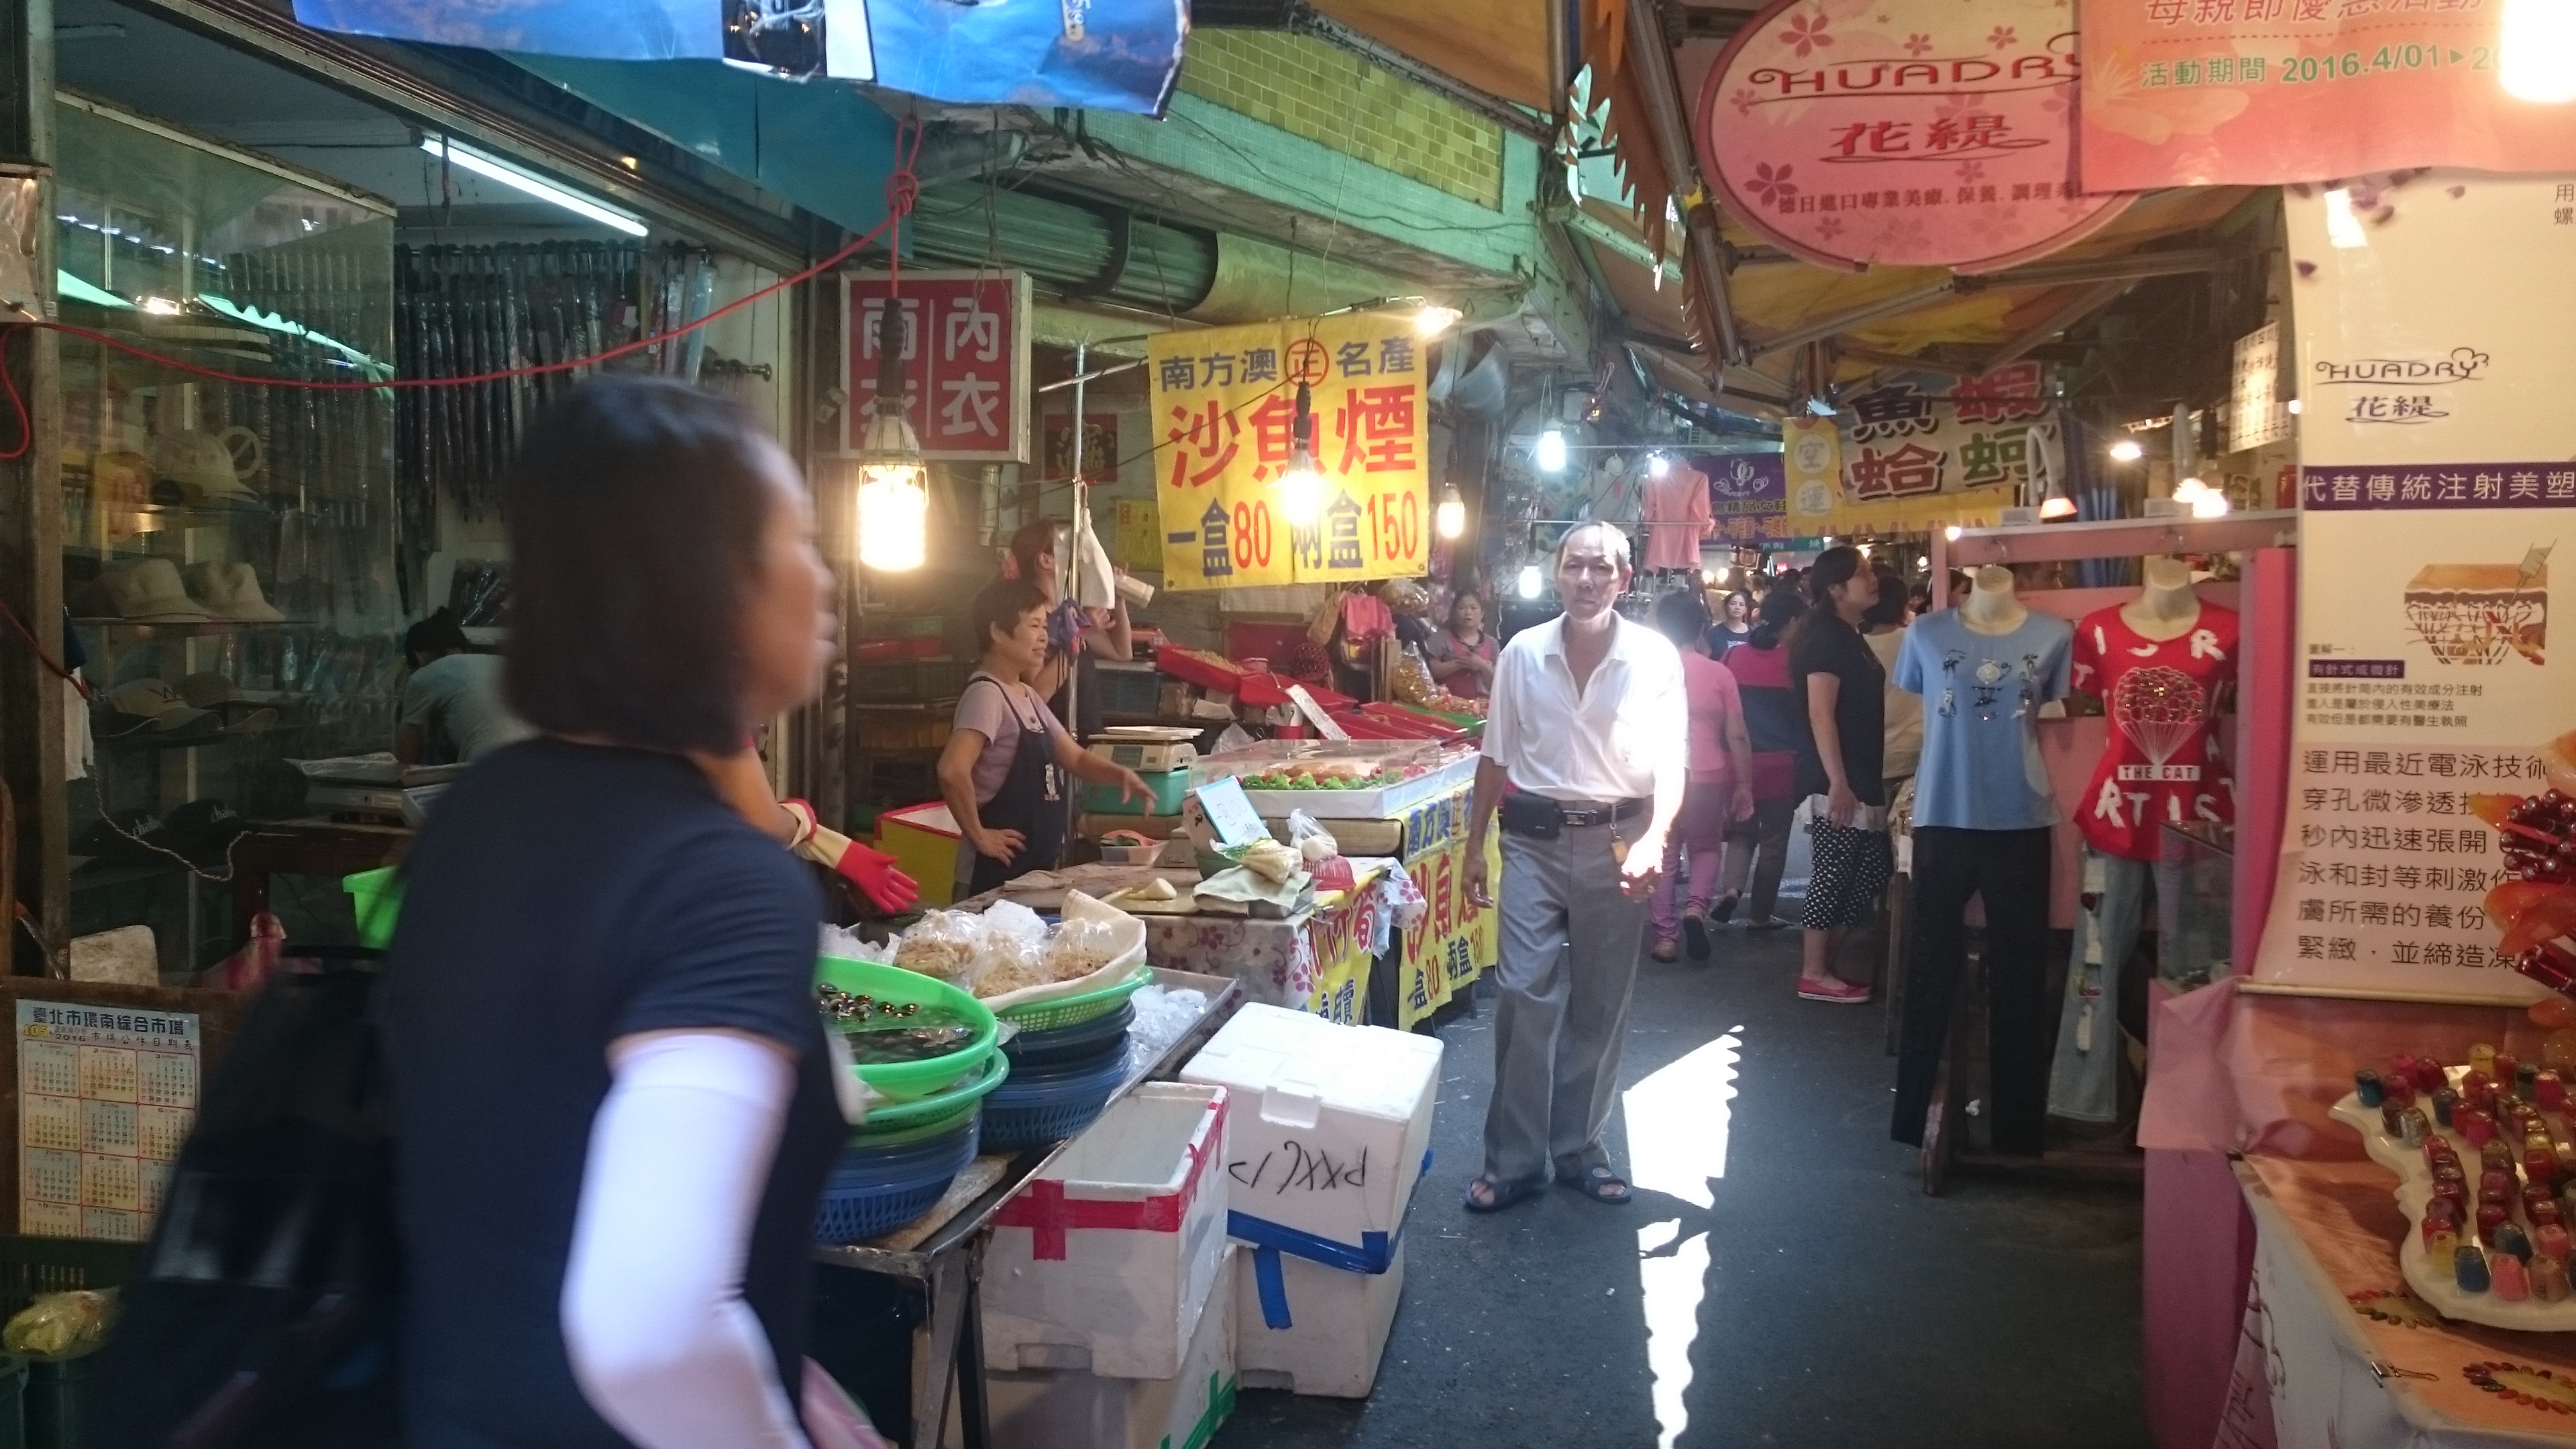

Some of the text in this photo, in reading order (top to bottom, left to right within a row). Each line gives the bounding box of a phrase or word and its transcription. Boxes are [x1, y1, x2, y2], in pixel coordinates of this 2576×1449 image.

[2142, 56, 2266, 88] 活動期間
[1829, 115, 2012, 156] 花緹
[941, 297, 1001, 437] 內衣
[2316, 358, 2479, 380] HUADRY
[2351, 395, 2434, 418] 花緹
[1167, 384, 1417, 490] 沙魚煙
[2304, 471, 2575, 502] 代替傳統注射美塑
[2123, 766, 2194, 780] THE CAT
[2300, 824, 2487, 854] 秒內迅速張開
[2297, 899, 2485, 930] 膚所需的養份
